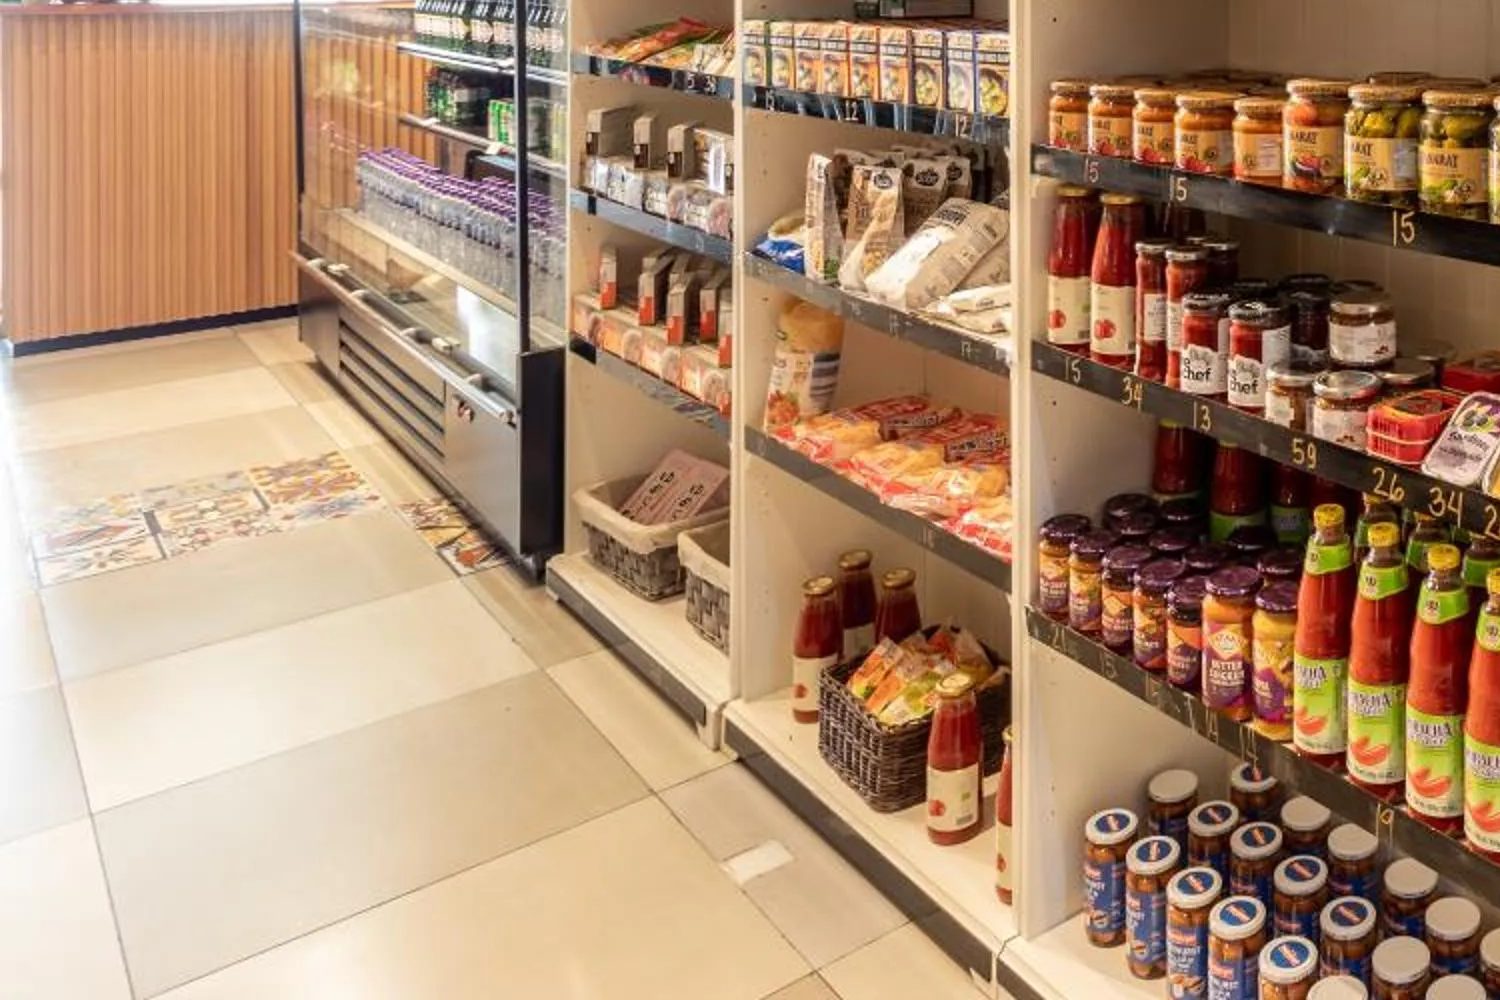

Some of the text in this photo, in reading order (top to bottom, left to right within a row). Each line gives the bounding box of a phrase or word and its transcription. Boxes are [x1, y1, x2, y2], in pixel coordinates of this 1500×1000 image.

[1169, 174, 1189, 202] 15
[1392, 209, 1416, 247] 15
[1065, 355, 1082, 383] 15
[1192, 400, 1213, 432] 13
[1372, 466, 1405, 501] 26
[1428, 486, 1464, 528] 34
